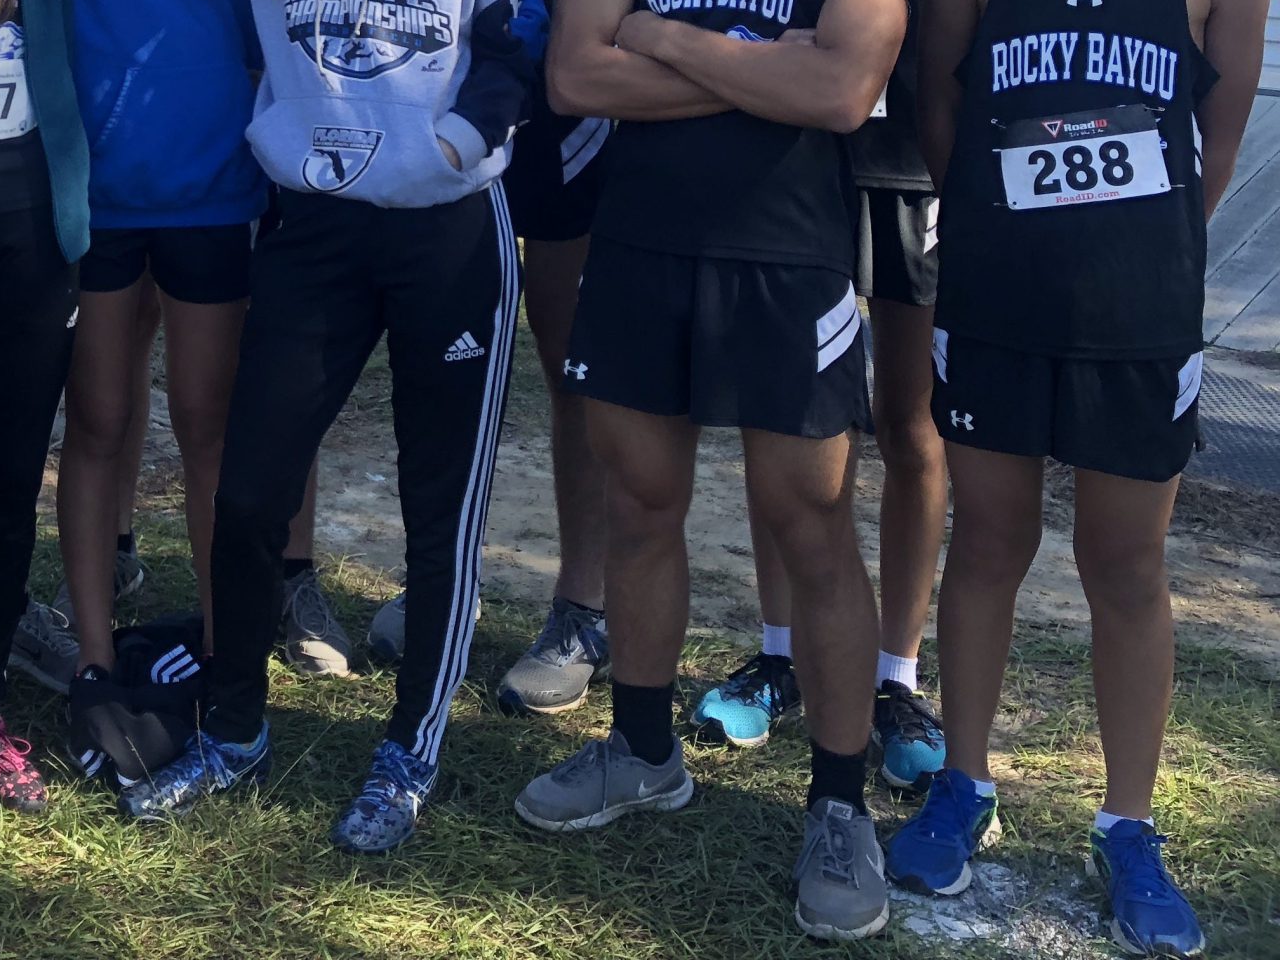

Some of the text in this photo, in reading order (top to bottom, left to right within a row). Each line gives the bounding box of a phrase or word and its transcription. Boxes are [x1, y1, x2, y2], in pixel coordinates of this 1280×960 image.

[992, 31, 1178, 101] ROCKY BAYOU
[1063, 119, 1108, 132] RoadID
[1028, 140, 1134, 196] 288
[1055, 191, 1120, 204] RoadID.com
[445, 347, 485, 361] adidas
